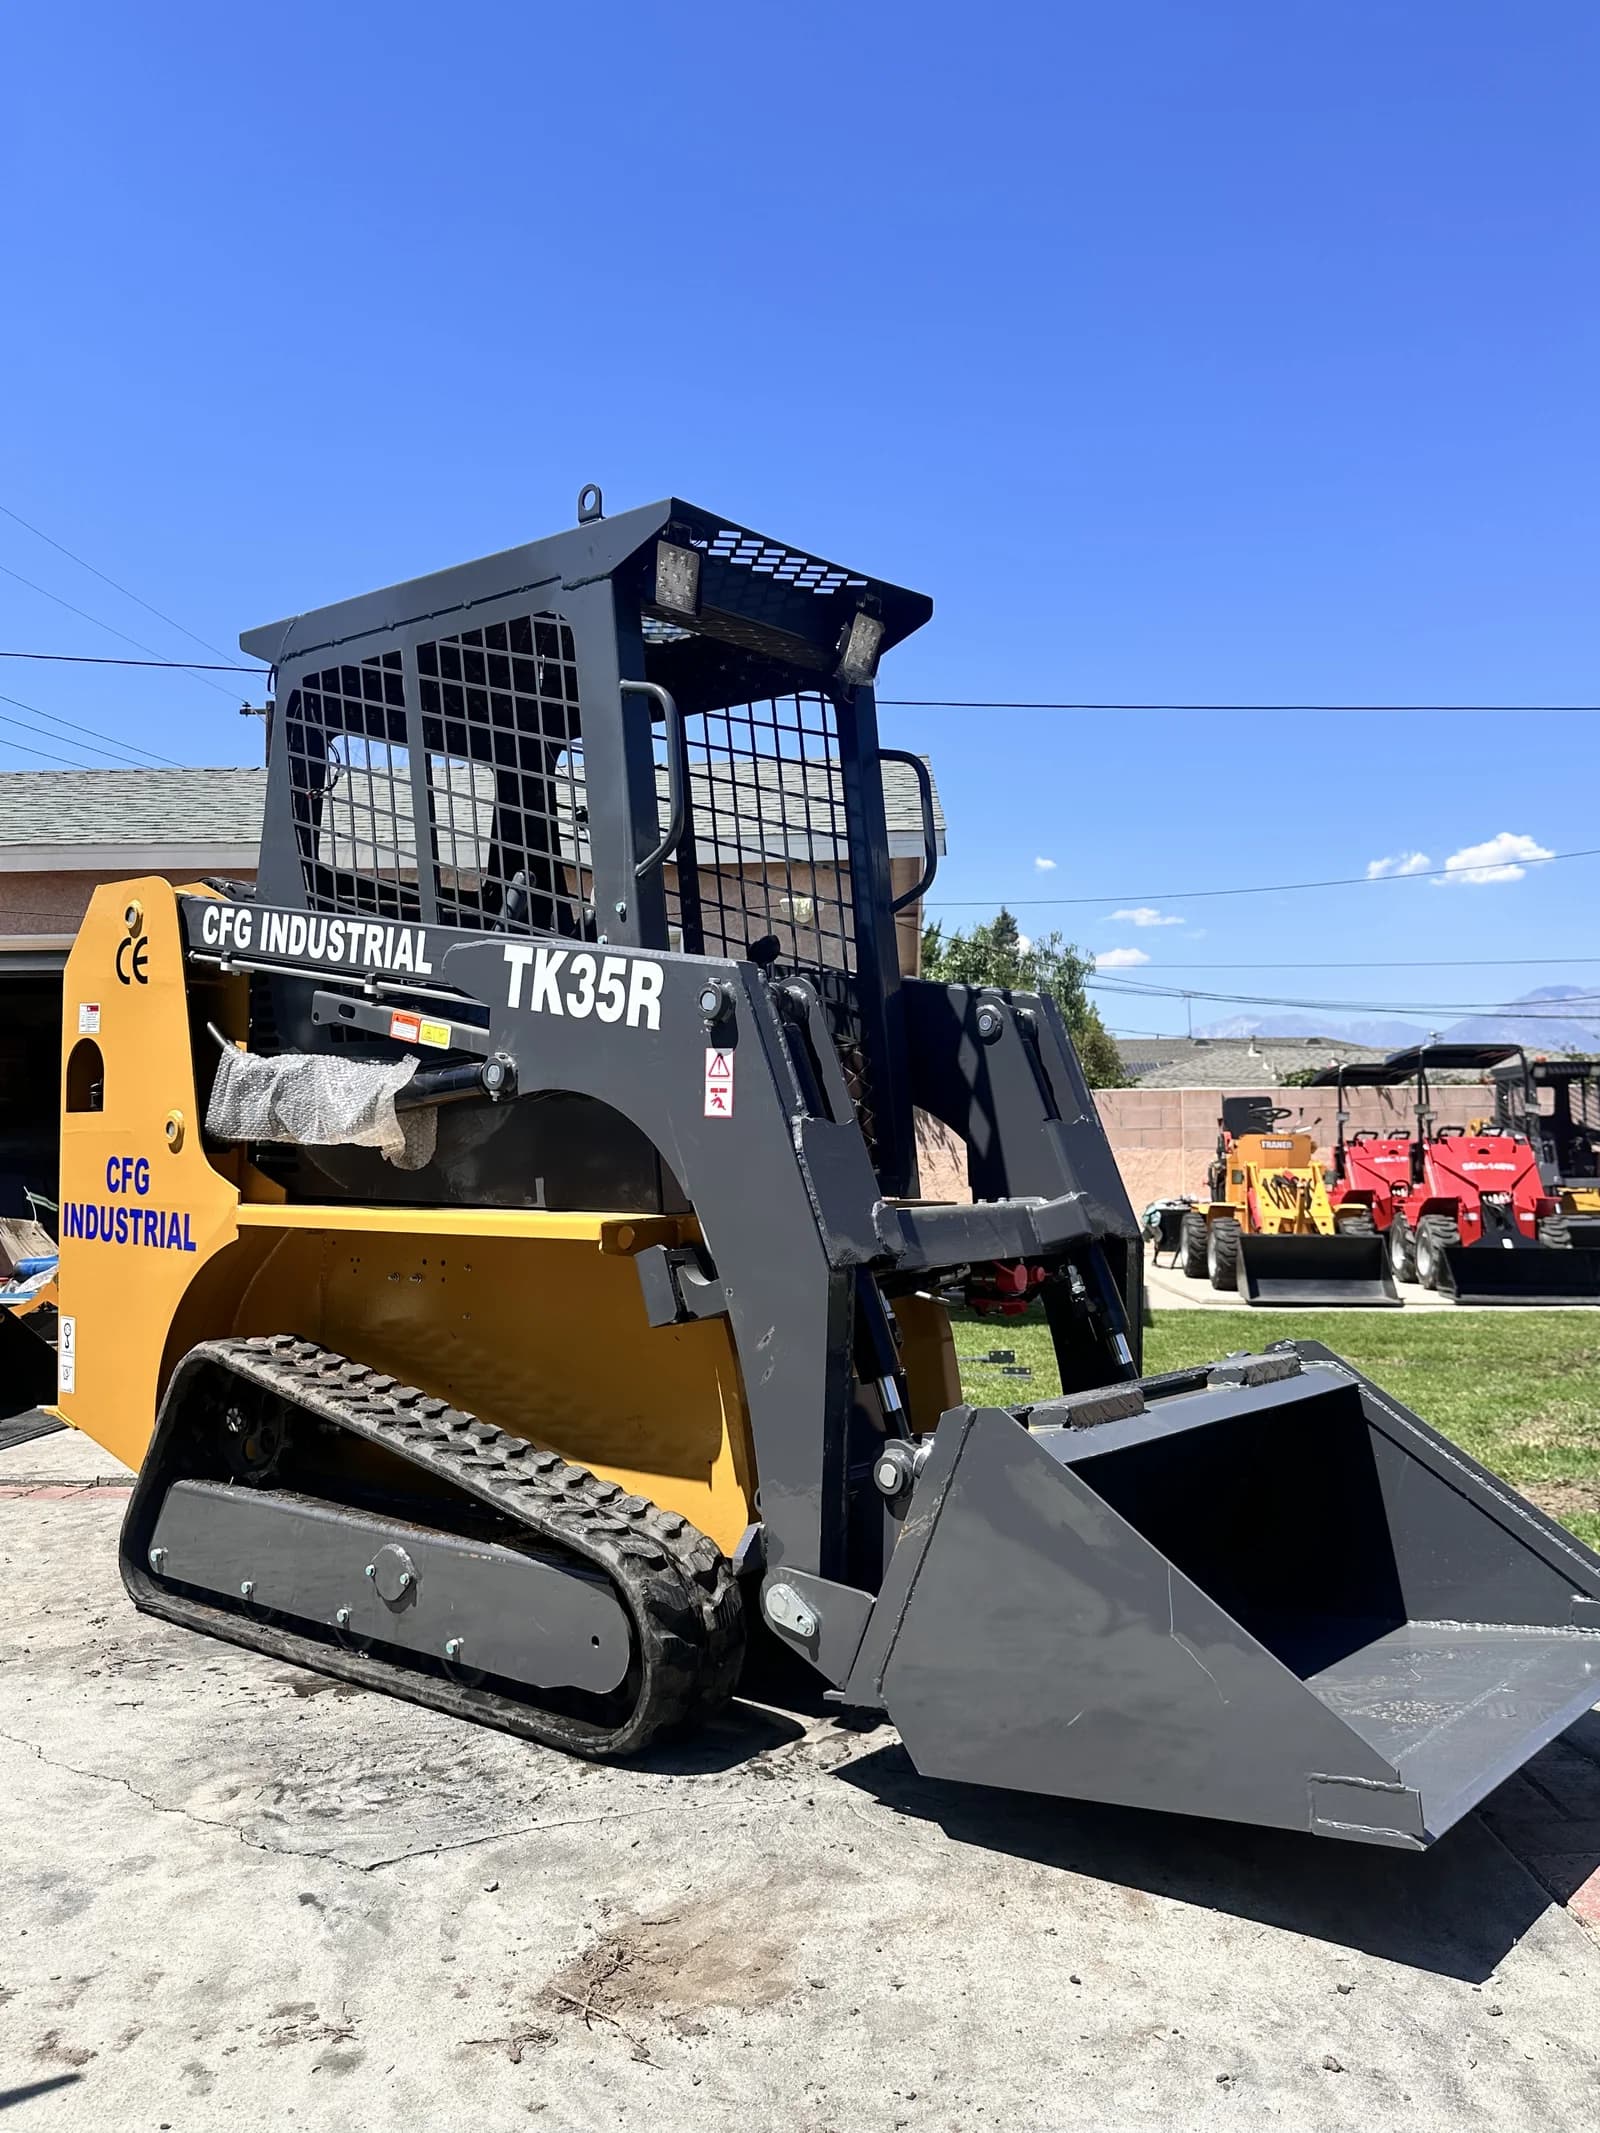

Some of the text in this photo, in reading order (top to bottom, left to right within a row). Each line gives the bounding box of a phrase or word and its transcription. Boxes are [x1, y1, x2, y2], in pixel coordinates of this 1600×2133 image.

[115, 936, 148, 985] CE
[203, 905, 433, 975] CFG INDUSTRIAL
[503, 944, 664, 1031] TK35R
[106, 1156, 150, 1195] CFG
[63, 1202, 197, 1252] INDUSTRIAL
